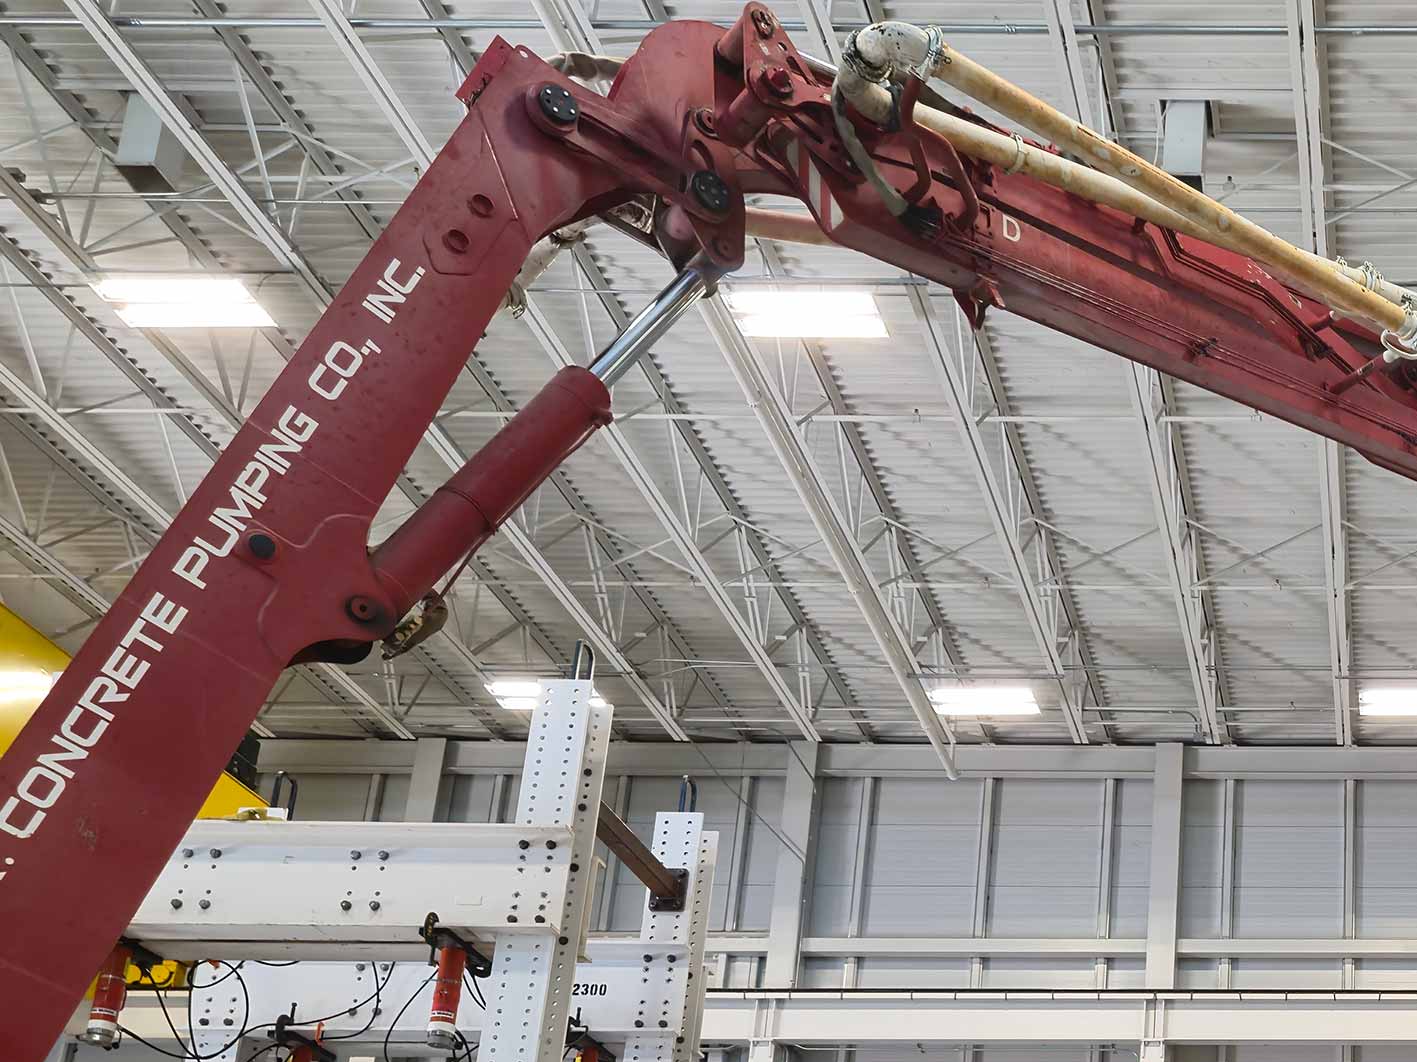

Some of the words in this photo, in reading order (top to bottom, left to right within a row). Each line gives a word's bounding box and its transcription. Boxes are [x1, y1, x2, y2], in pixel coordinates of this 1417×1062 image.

[0, 592, 189, 839] CONCRETE
[172, 405, 319, 591] PUMPING
[308, 339, 383, 401] CO.,
[361, 258, 426, 325] INC.
[572, 983, 608, 996] 2300
